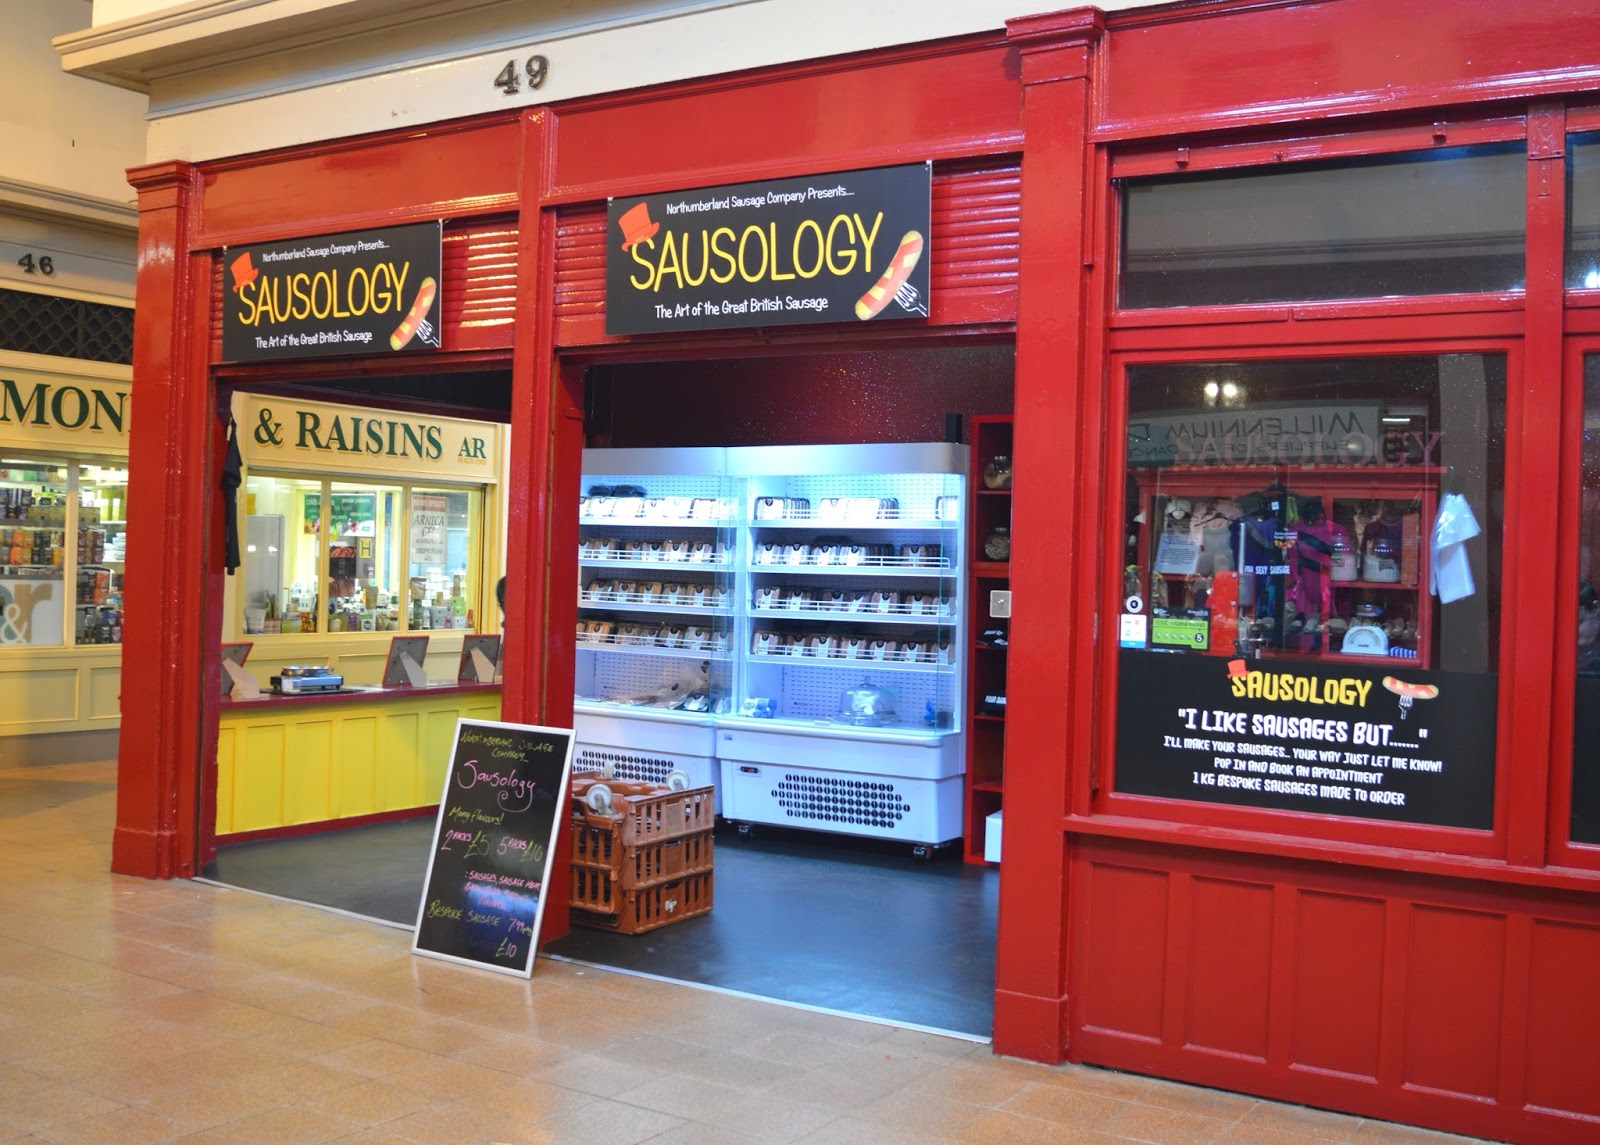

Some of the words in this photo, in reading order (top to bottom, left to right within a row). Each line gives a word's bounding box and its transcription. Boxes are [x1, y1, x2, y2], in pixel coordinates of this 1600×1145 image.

[494, 55, 550, 94] 49
[666, 197, 730, 216] Northumberland
[731, 194, 766, 210] Sausage
[766, 190, 807, 206] Company
[18, 253, 54, 275] 46
[262, 248, 306, 263] Northumberland
[306, 246, 330, 258] Sausage
[330, 243, 357, 256] Company
[630, 211, 884, 292] SAUSOLOGY
[238, 261, 410, 326] SAUSOLOGY
[654, 304, 672, 319] The
[674, 302, 691, 317] Art
[692, 300, 702, 316] of
[704, 300, 720, 315] the
[721, 298, 748, 314] Great
[750, 295, 783, 312] British
[785, 296, 829, 312] Sausage
[255, 336, 268, 349] The
[268, 334, 280, 348] Art
[280, 334, 288, 347] of
[288, 332, 300, 346] the
[300, 332, 318, 346] Great
[319, 330, 342, 344] British
[343, 331, 373, 344] Sausage
[0, 379, 132, 433] MON
[254, 408, 284, 446] &
[296, 410, 442, 460] RAISINS
[458, 436, 487, 460] AR
[414, 514, 444, 526] ARNICA
[1255, 566, 1268, 574] SEXY
[1269, 565, 1290, 574] SAUSAGE
[1196, 634, 1203, 642] 5
[1231, 671, 1373, 707] SAUSOLOGY
[1178, 708, 1198, 730] "I
[1201, 710, 1248, 734] LIKE
[1252, 714, 1348, 742] SAUSAGES
[1163, 736, 1183, 748] I'LL
[1184, 738, 1210, 751] MAKE
[1212, 740, 1236, 753] YOUR
[1292, 748, 1318, 760] YOUR
[1318, 750, 1341, 763] WAY
[1343, 752, 1370, 766] JUST
[1370, 755, 1390, 768] LET
[1392, 757, 1408, 770] ME
[1409, 759, 1443, 773] KNOW!
[1214, 757, 1232, 769] POP
[1233, 758, 1246, 771] IN
[1248, 760, 1268, 773] AND
[1269, 762, 1294, 776] BOOK
[1295, 765, 1310, 778] AN
[1311, 766, 1383, 785] APPOINTMENT
[457, 760, 536, 812] Sausology
[1192, 772, 1199, 784] 1
[1200, 773, 1216, 786] KG
[1217, 774, 1262, 791] BESPOKE
[1264, 779, 1318, 796] SAUSAGES
[1320, 785, 1352, 800] MADE
[1353, 788, 1368, 802] TO
[1369, 791, 1406, 806] ORDER
[441, 829, 454, 850] 2
[453, 830, 472, 841] PACKS
[464, 830, 492, 859] £5
[497, 836, 510, 855] 5
[508, 838, 528, 850] PACKS
[520, 840, 543, 862] £10
[499, 875, 525, 887] SAUSAGE
[427, 900, 463, 920] BESPOKE
[466, 910, 501, 926] SAUSAGE
[496, 937, 517, 957] £10
